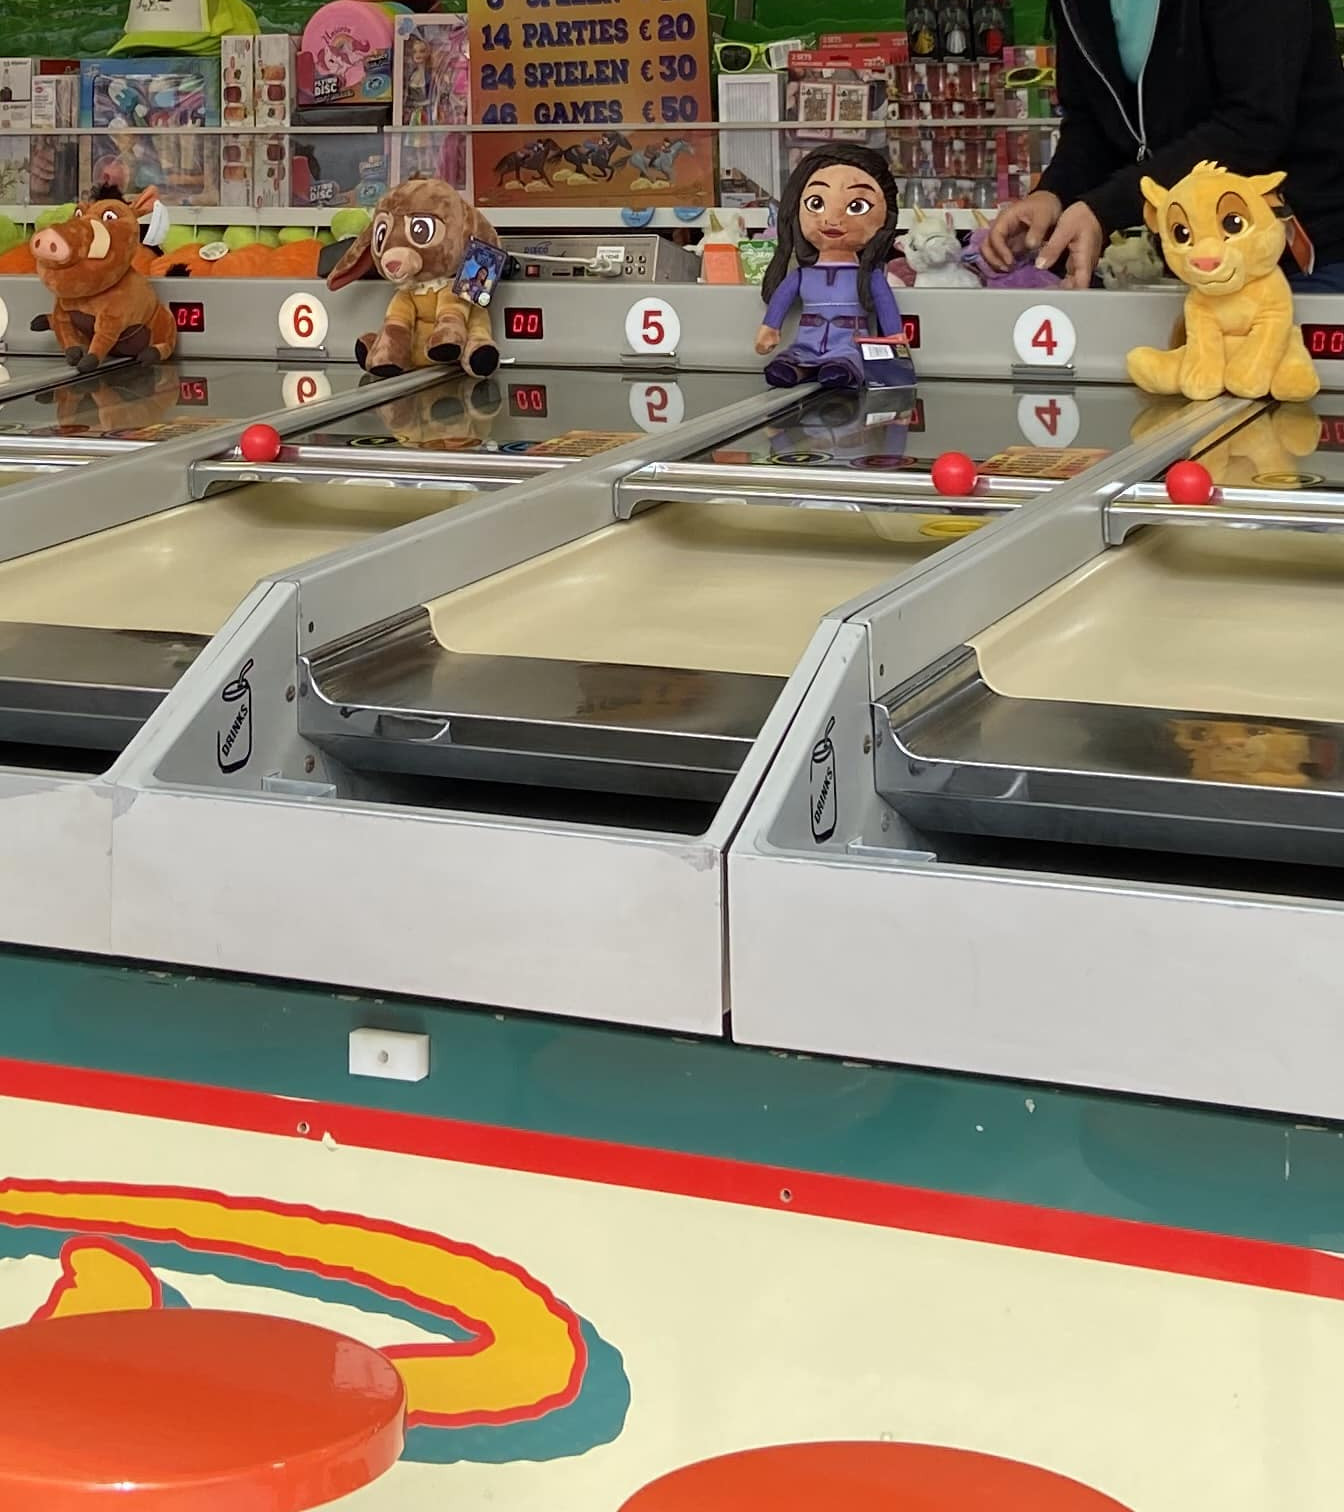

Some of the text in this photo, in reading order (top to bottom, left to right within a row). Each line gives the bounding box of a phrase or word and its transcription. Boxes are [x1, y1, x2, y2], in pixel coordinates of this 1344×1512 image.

[482, 13, 696, 51] 14 PARTIES € 20
[315, 84, 338, 95] DISC
[481, 54, 697, 91] 24 SPIELEN € 30
[482, 95, 698, 125] 46 GAMES € 50
[309, 190, 334, 201] DISC
[176, 307, 199, 326] 02
[293, 304, 315, 338] 6
[513, 314, 539, 333] 00
[641, 310, 665, 345] 5
[1031, 319, 1058, 356] 4
[1312, 331, 1344, 353] 00
[221, 703, 249, 758] DRINKS
[814, 766, 833, 825] DRINKS
